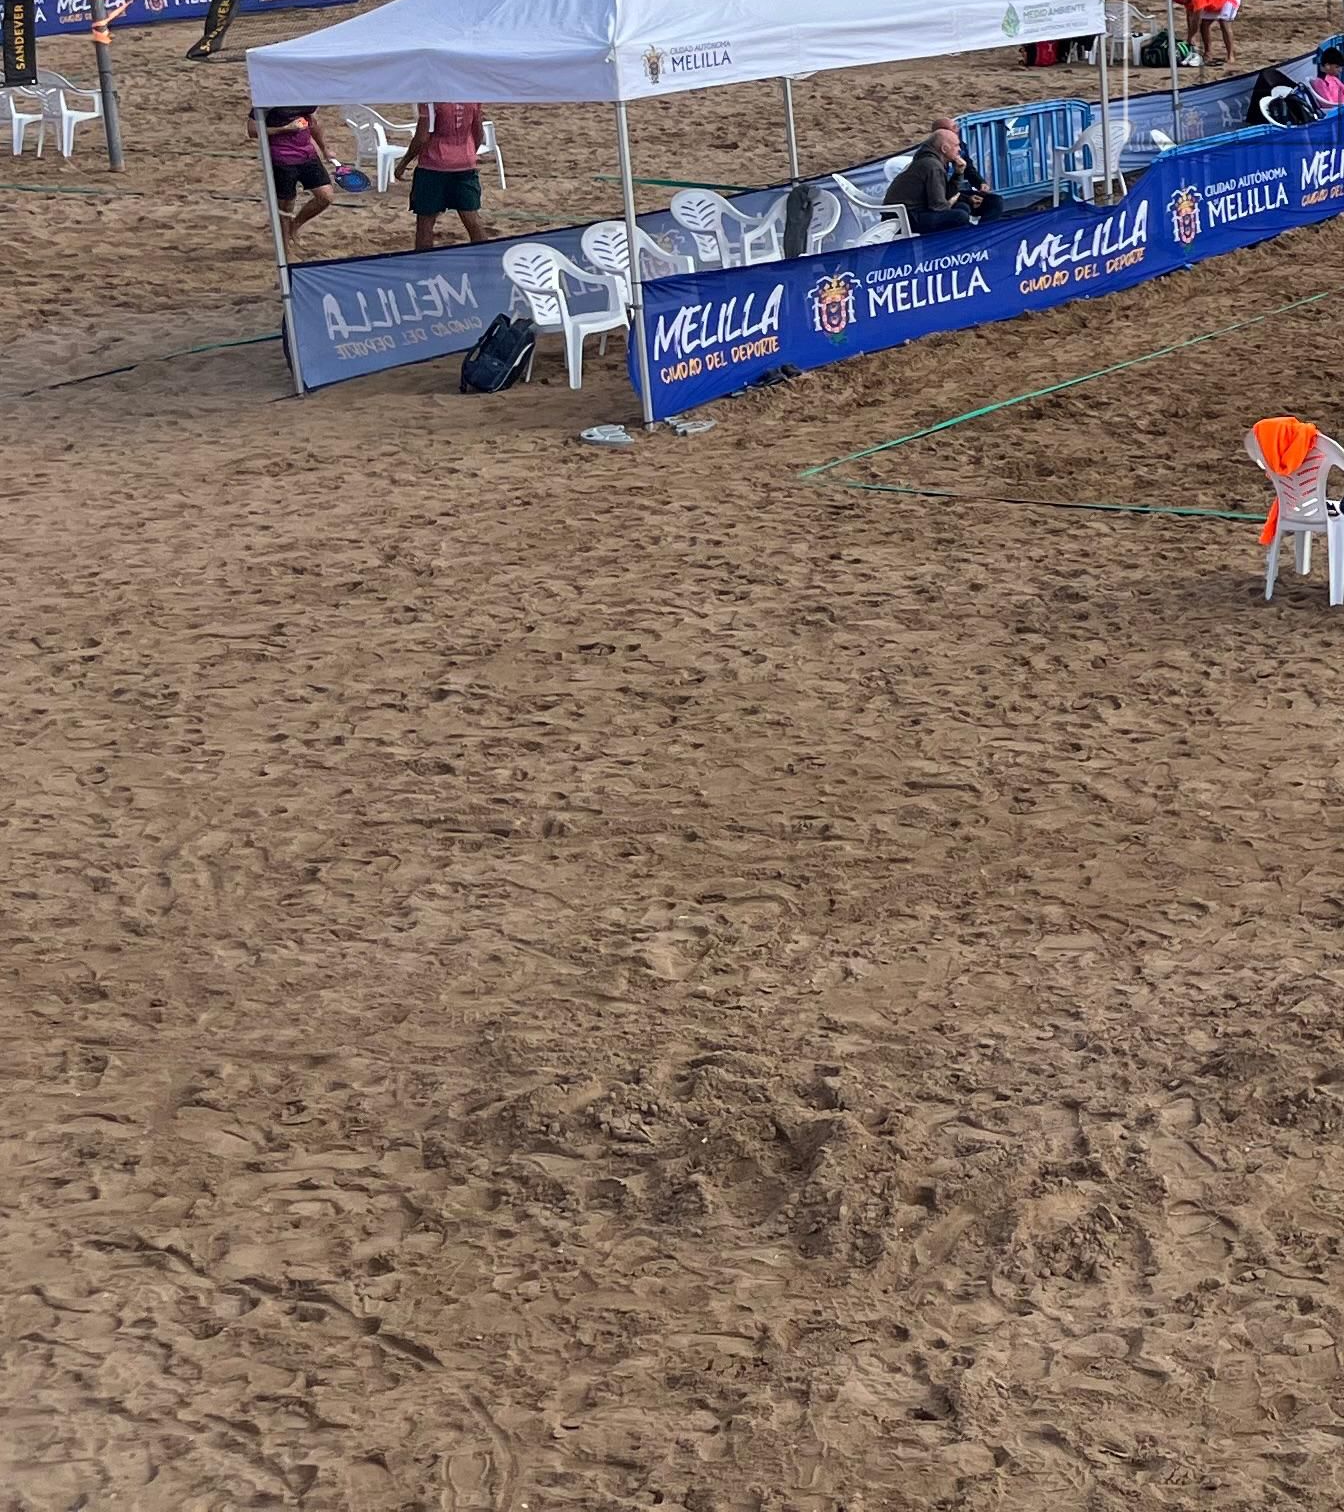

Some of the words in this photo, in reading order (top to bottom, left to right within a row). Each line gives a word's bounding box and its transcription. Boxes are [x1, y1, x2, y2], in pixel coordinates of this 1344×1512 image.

[14, 3, 27, 71] SANDEVER
[671, 50, 732, 72] MELILLA
[1204, 179, 1237, 197] CIUDAD
[1238, 166, 1287, 190] AUTÓNOMA
[1207, 182, 1289, 228] MELILLA
[1015, 199, 1149, 276] MELILLA
[866, 264, 912, 284] CIUDAD
[868, 266, 992, 319] MELILLA
[1020, 270, 1069, 295] CIUDAD
[1075, 262, 1100, 281] DEL
[1106, 247, 1145, 275] DEPORTE
[654, 284, 785, 361] MELILLA
[660, 358, 703, 384] CIUDAD
[706, 352, 728, 371] DEL
[731, 336, 779, 364] DEPORTE
